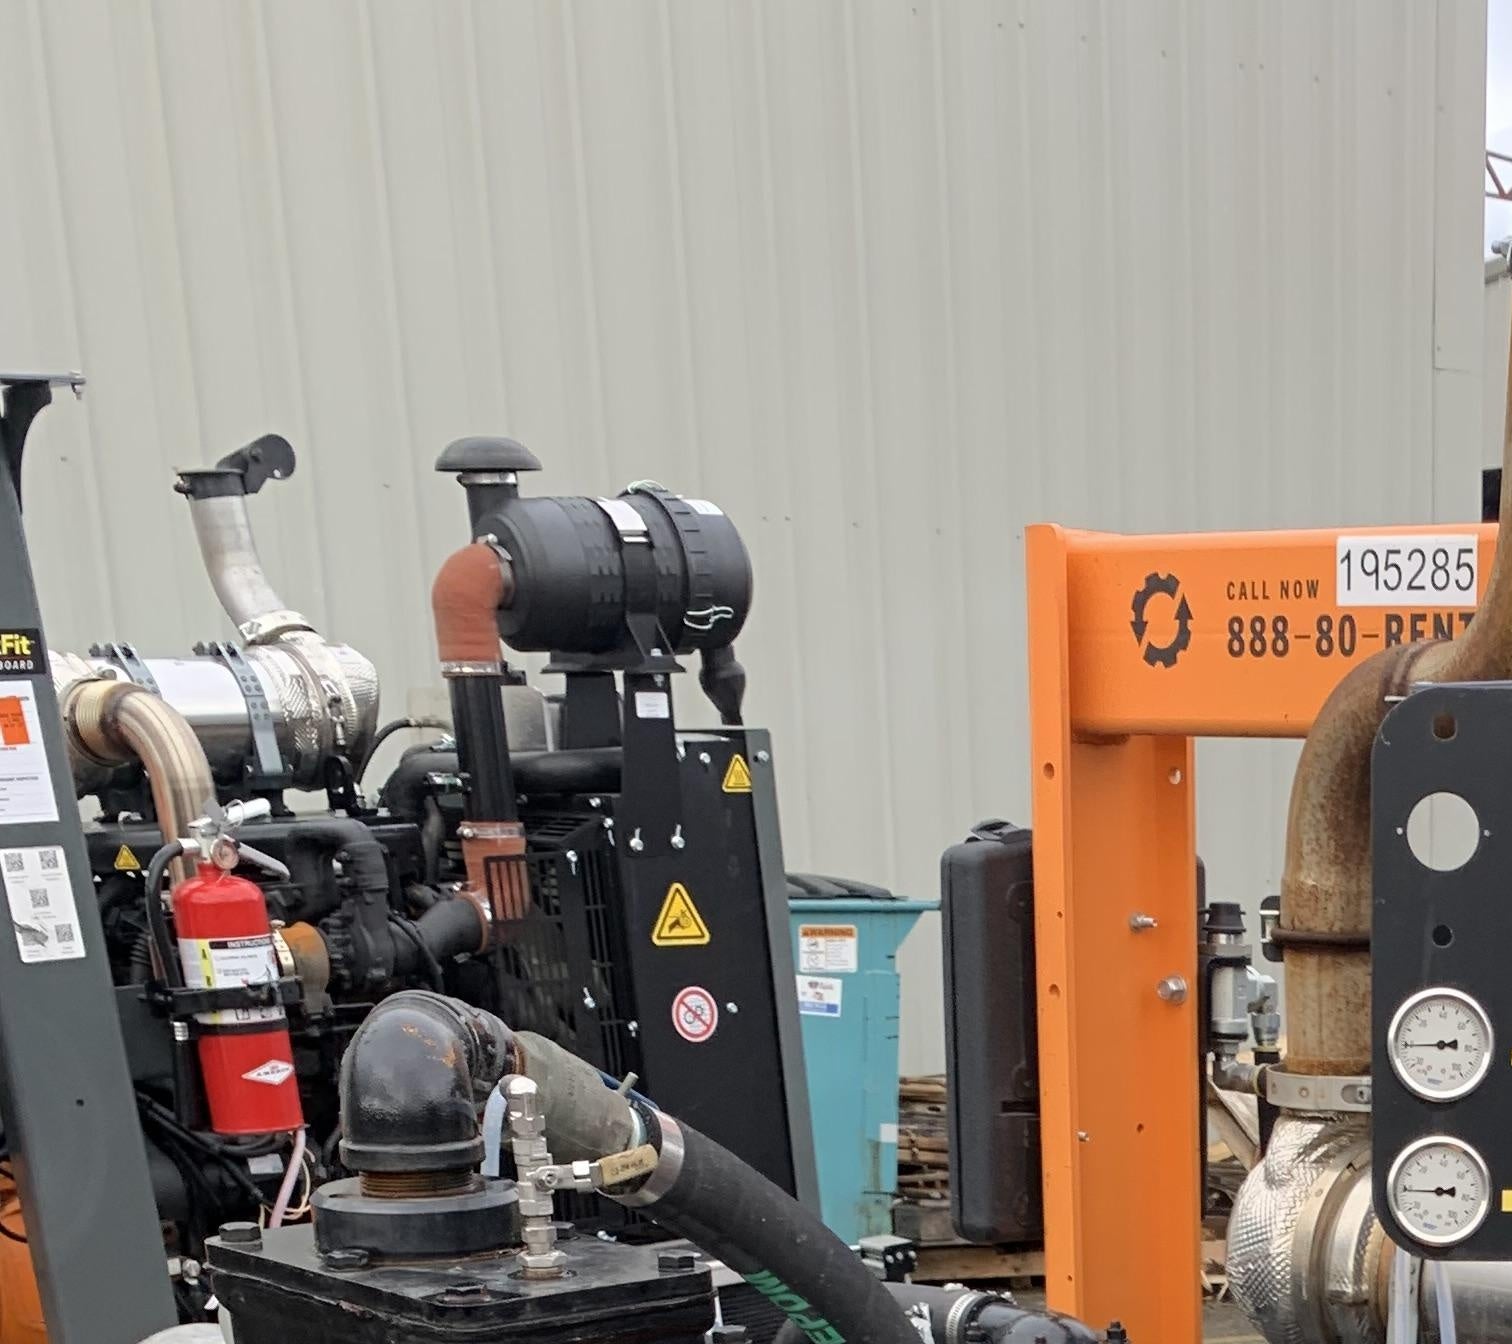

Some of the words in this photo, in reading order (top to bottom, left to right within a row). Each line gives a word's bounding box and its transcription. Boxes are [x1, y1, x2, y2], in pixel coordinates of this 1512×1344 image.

[1340, 548, 1475, 592] 195285
[1227, 581, 1271, 600] CALL
[1280, 580, 1320, 599] NOW
